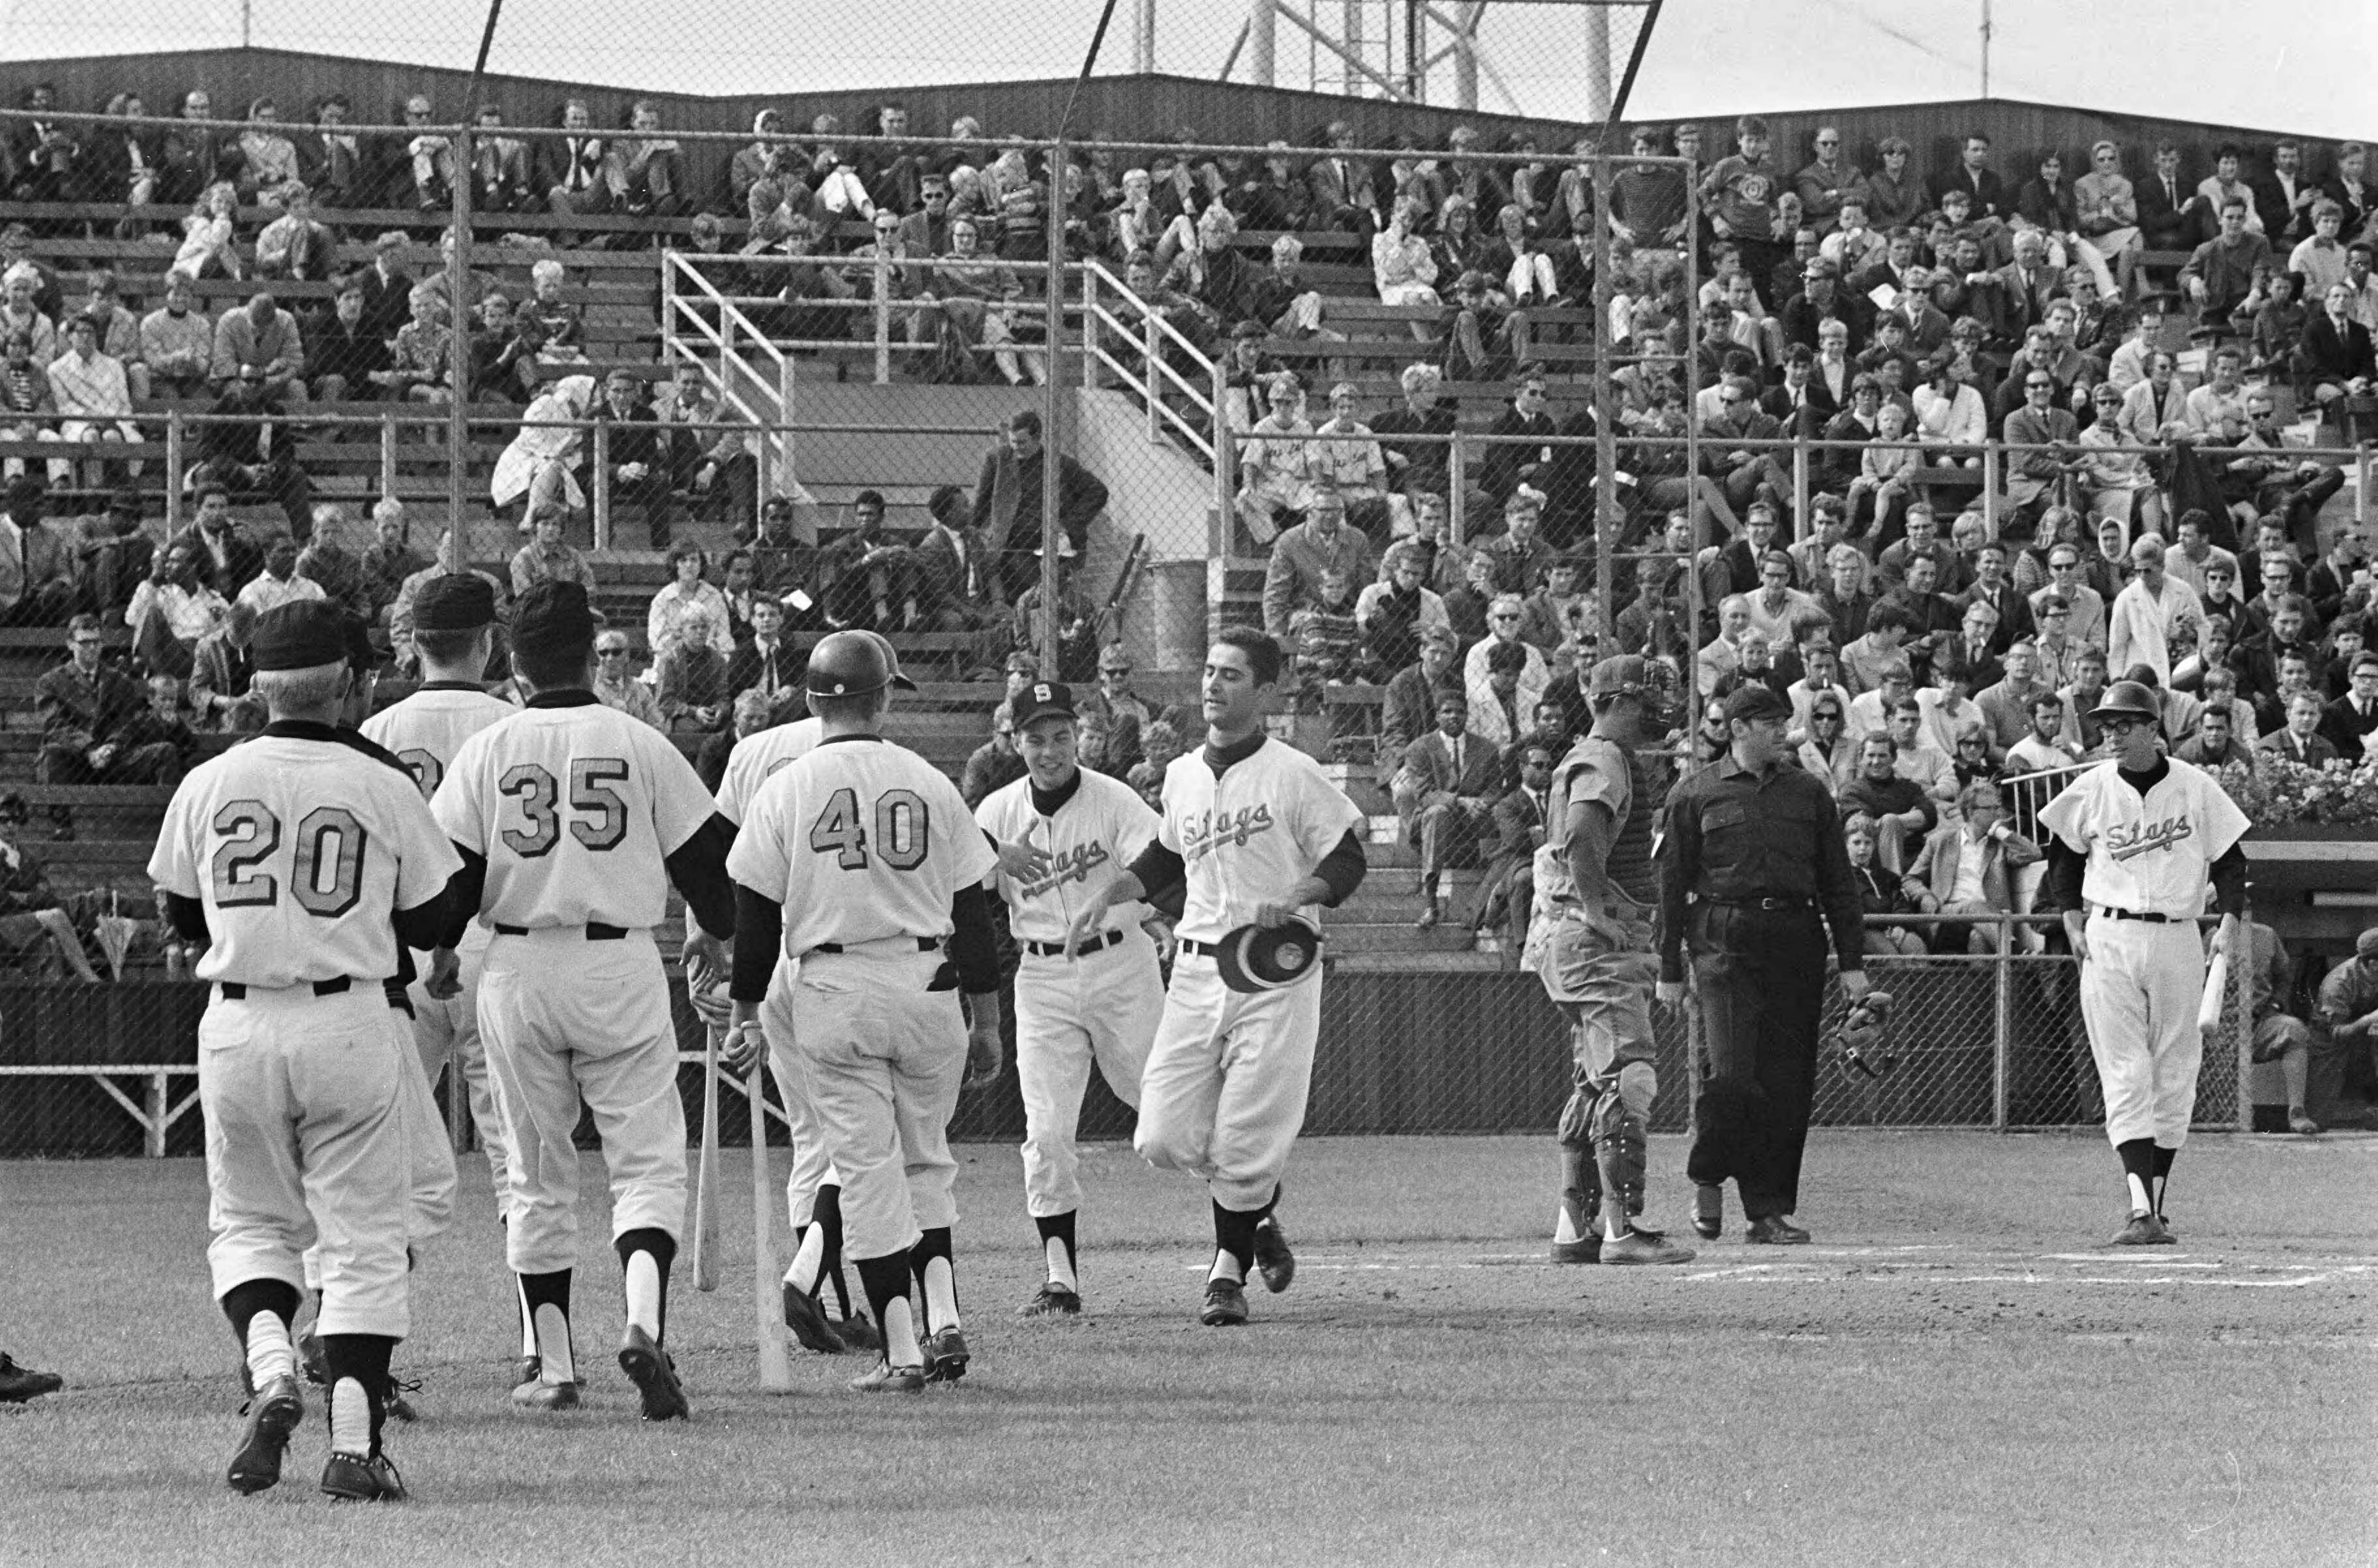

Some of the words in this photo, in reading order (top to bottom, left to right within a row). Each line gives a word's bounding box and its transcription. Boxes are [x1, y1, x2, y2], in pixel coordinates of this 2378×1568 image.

[1034, 684, 1051, 703] S
[499, 757, 629, 858] 35
[810, 787, 929, 871] 40
[1183, 802, 1273, 847] Stags
[2106, 814, 2192, 852] Stags
[212, 799, 368, 918] 20
